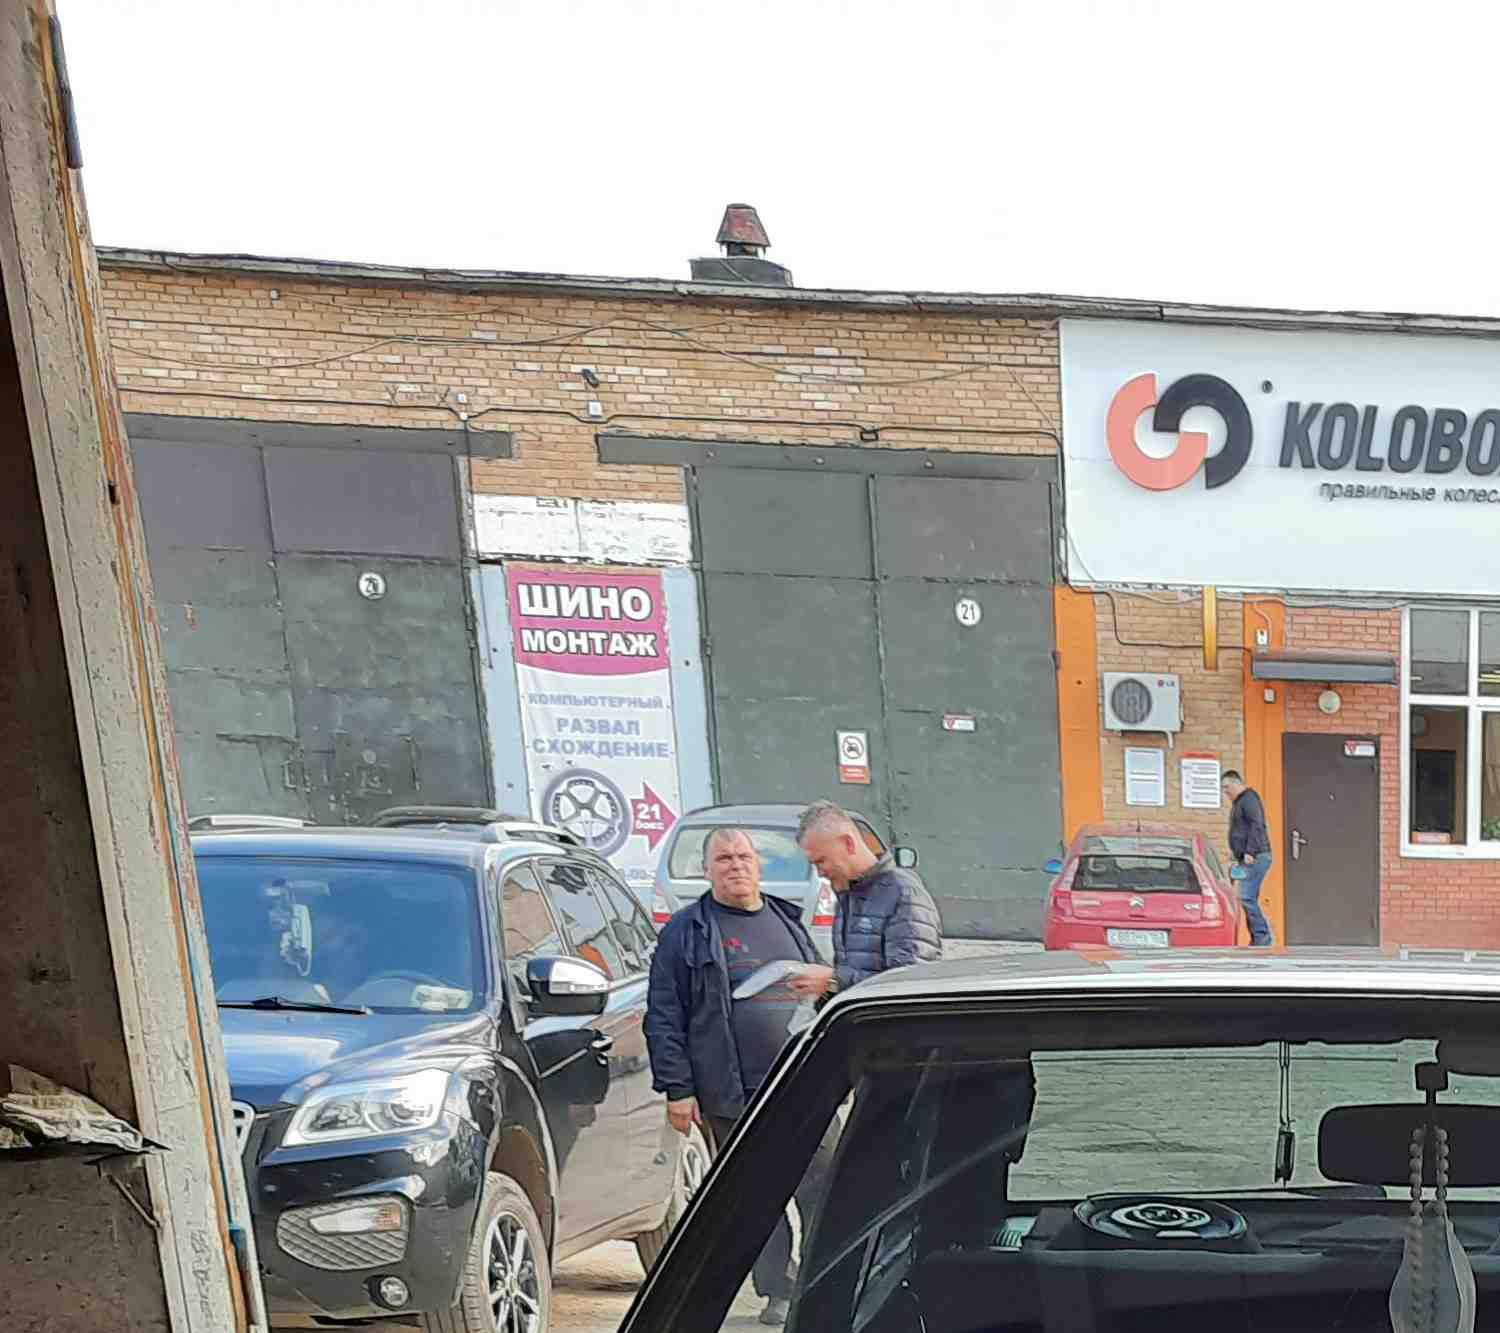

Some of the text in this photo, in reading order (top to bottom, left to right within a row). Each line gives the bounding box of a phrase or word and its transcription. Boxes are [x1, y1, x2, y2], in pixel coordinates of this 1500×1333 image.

[1319, 482, 1436, 501] правильные
[517, 584, 652, 621] ШИНО
[960, 603, 976, 620] 21
[521, 629, 659, 657] МОНТАЖ
[528, 691, 664, 709] КОМПЬЮТЕРНЫЙ
[556, 717, 641, 736] РАЗВАЛ
[532, 738, 669, 759] СХОЖДЕНИЕ
[636, 803, 661, 819] 21
